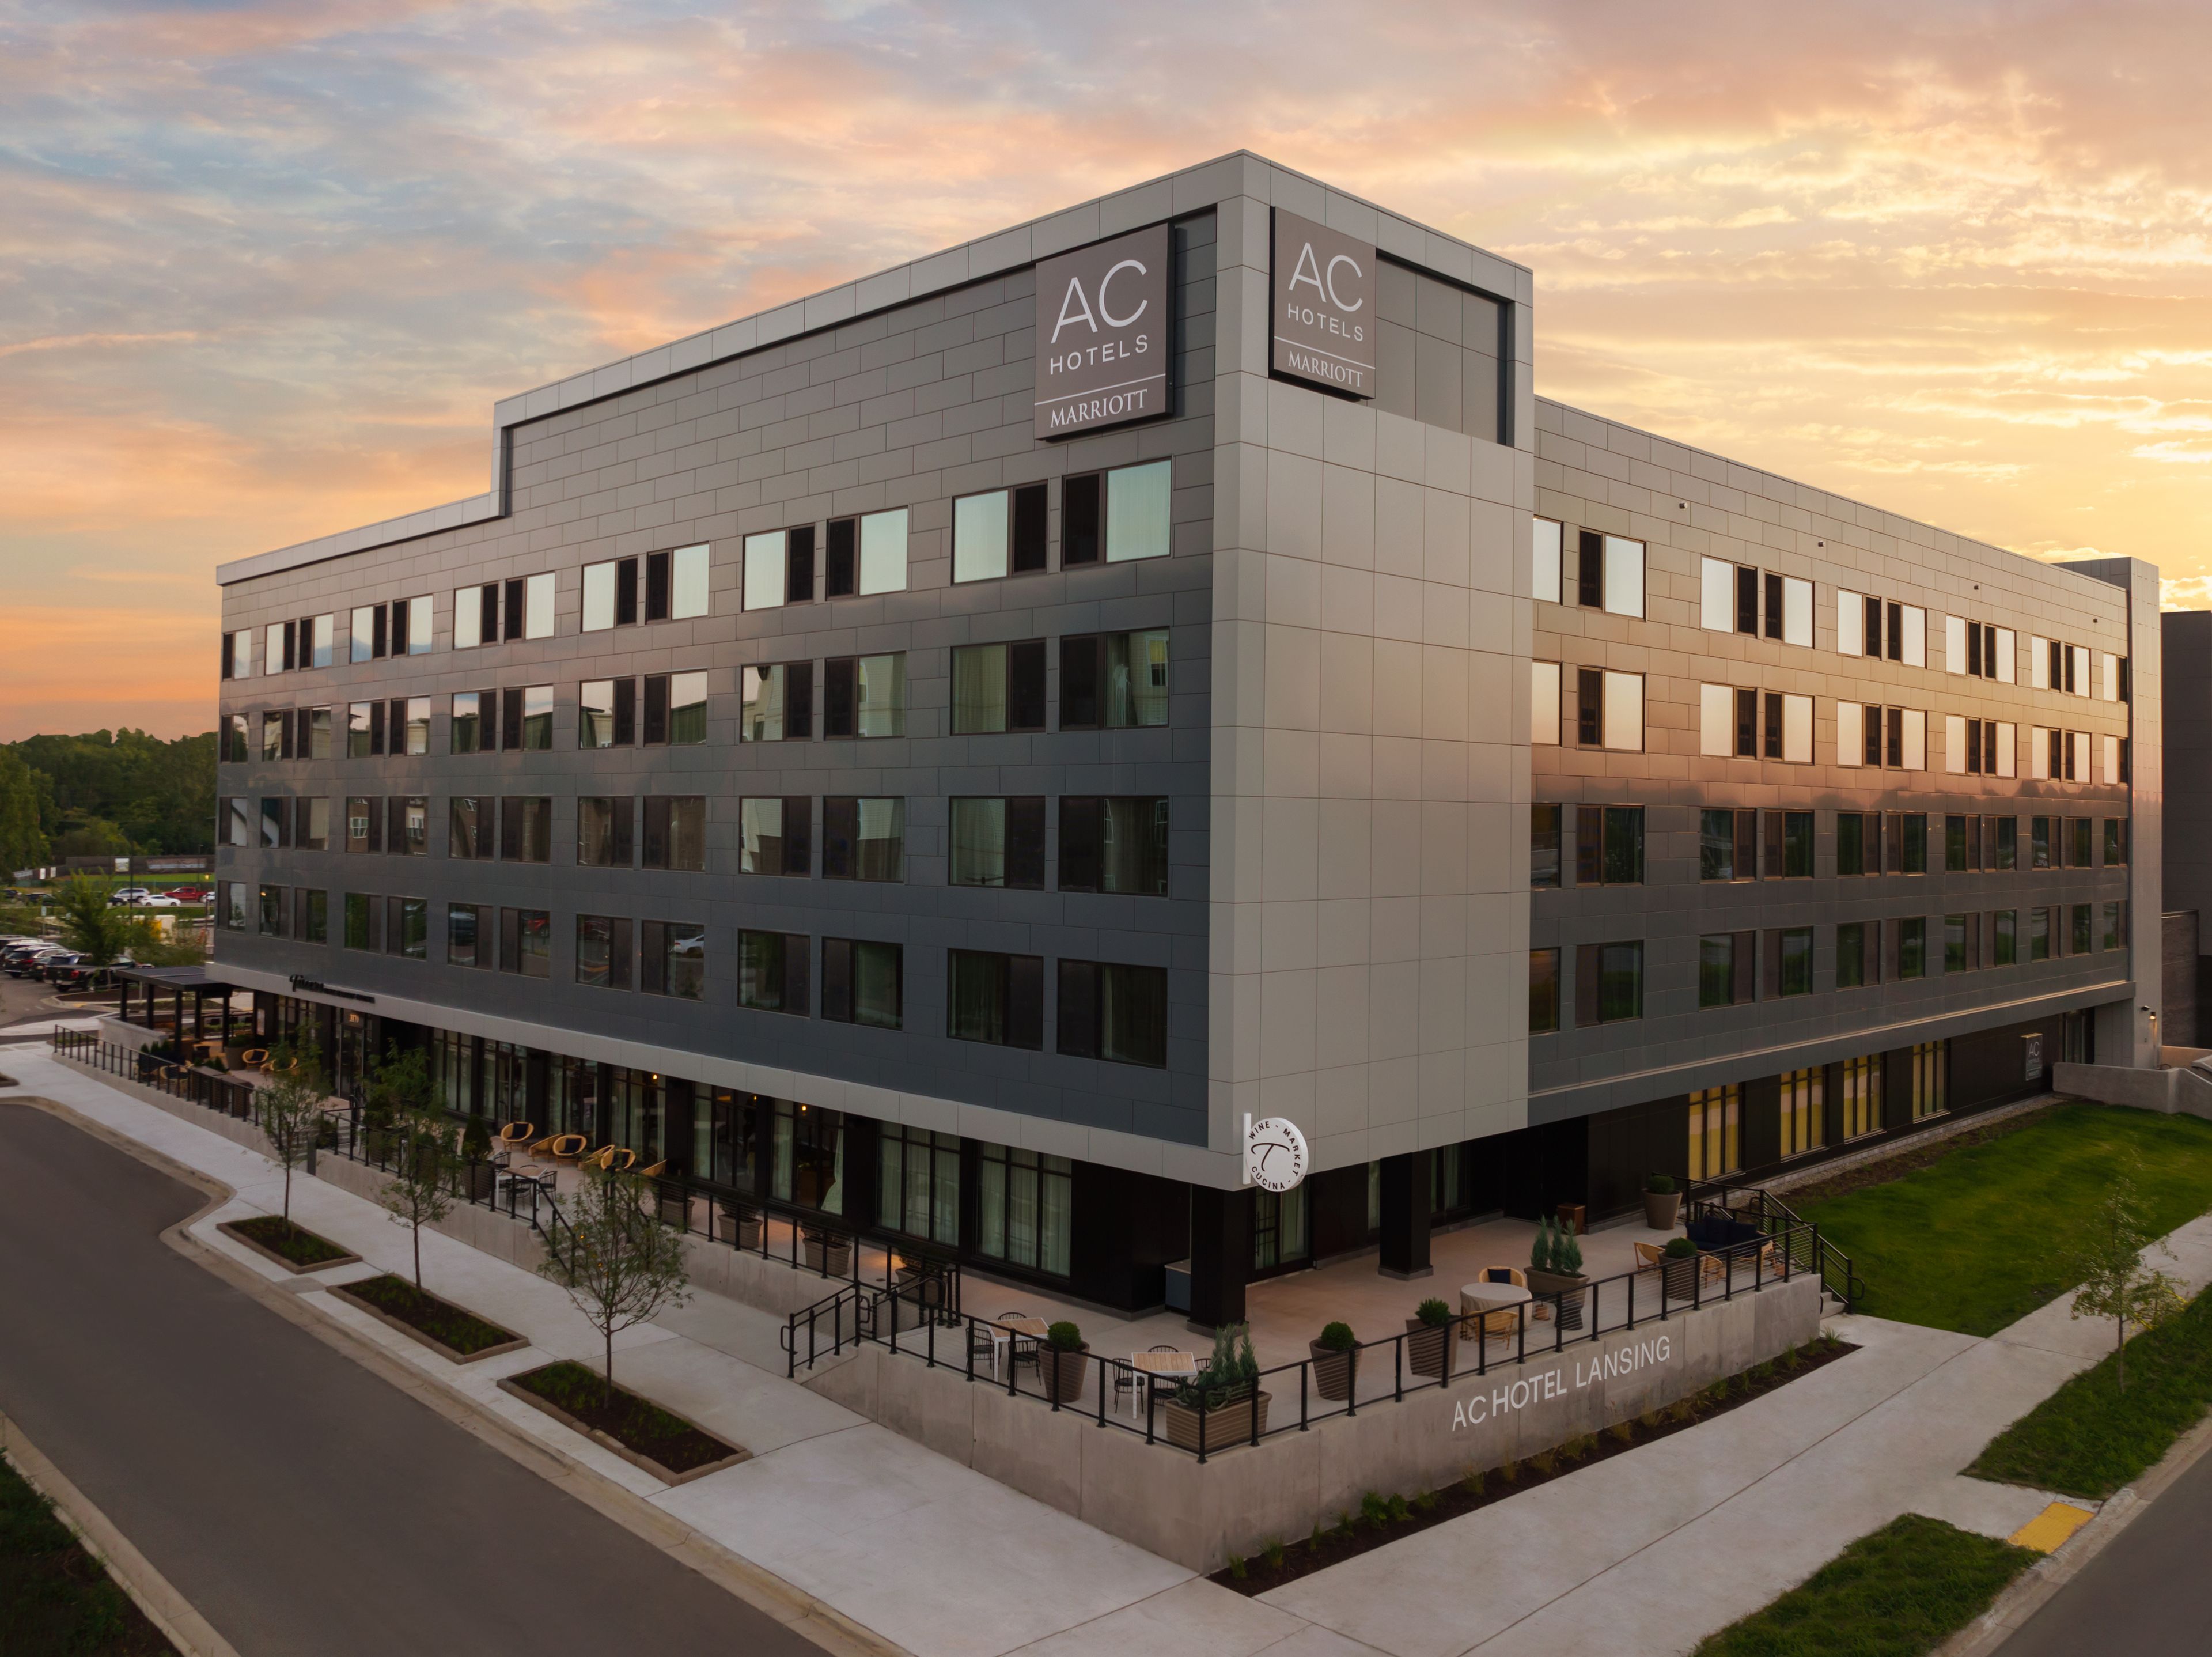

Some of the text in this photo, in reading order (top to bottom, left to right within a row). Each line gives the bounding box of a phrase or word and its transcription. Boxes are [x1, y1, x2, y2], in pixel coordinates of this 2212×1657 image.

[1288, 242, 1363, 312] AC
[1051, 259, 1148, 344] AC
[1288, 302, 1364, 342] HOTELS
[1050, 335, 1148, 374] HOTELS
[1288, 350, 1363, 388] MARRIOTT
[1050, 389, 1148, 428] MARRIOTT
[2028, 1042, 2040, 1058] AC
[1249, 1121, 1301, 1190] WINE MARKET CUCINA
[1452, 1335, 1671, 1432] AC HOTEL LANSING
